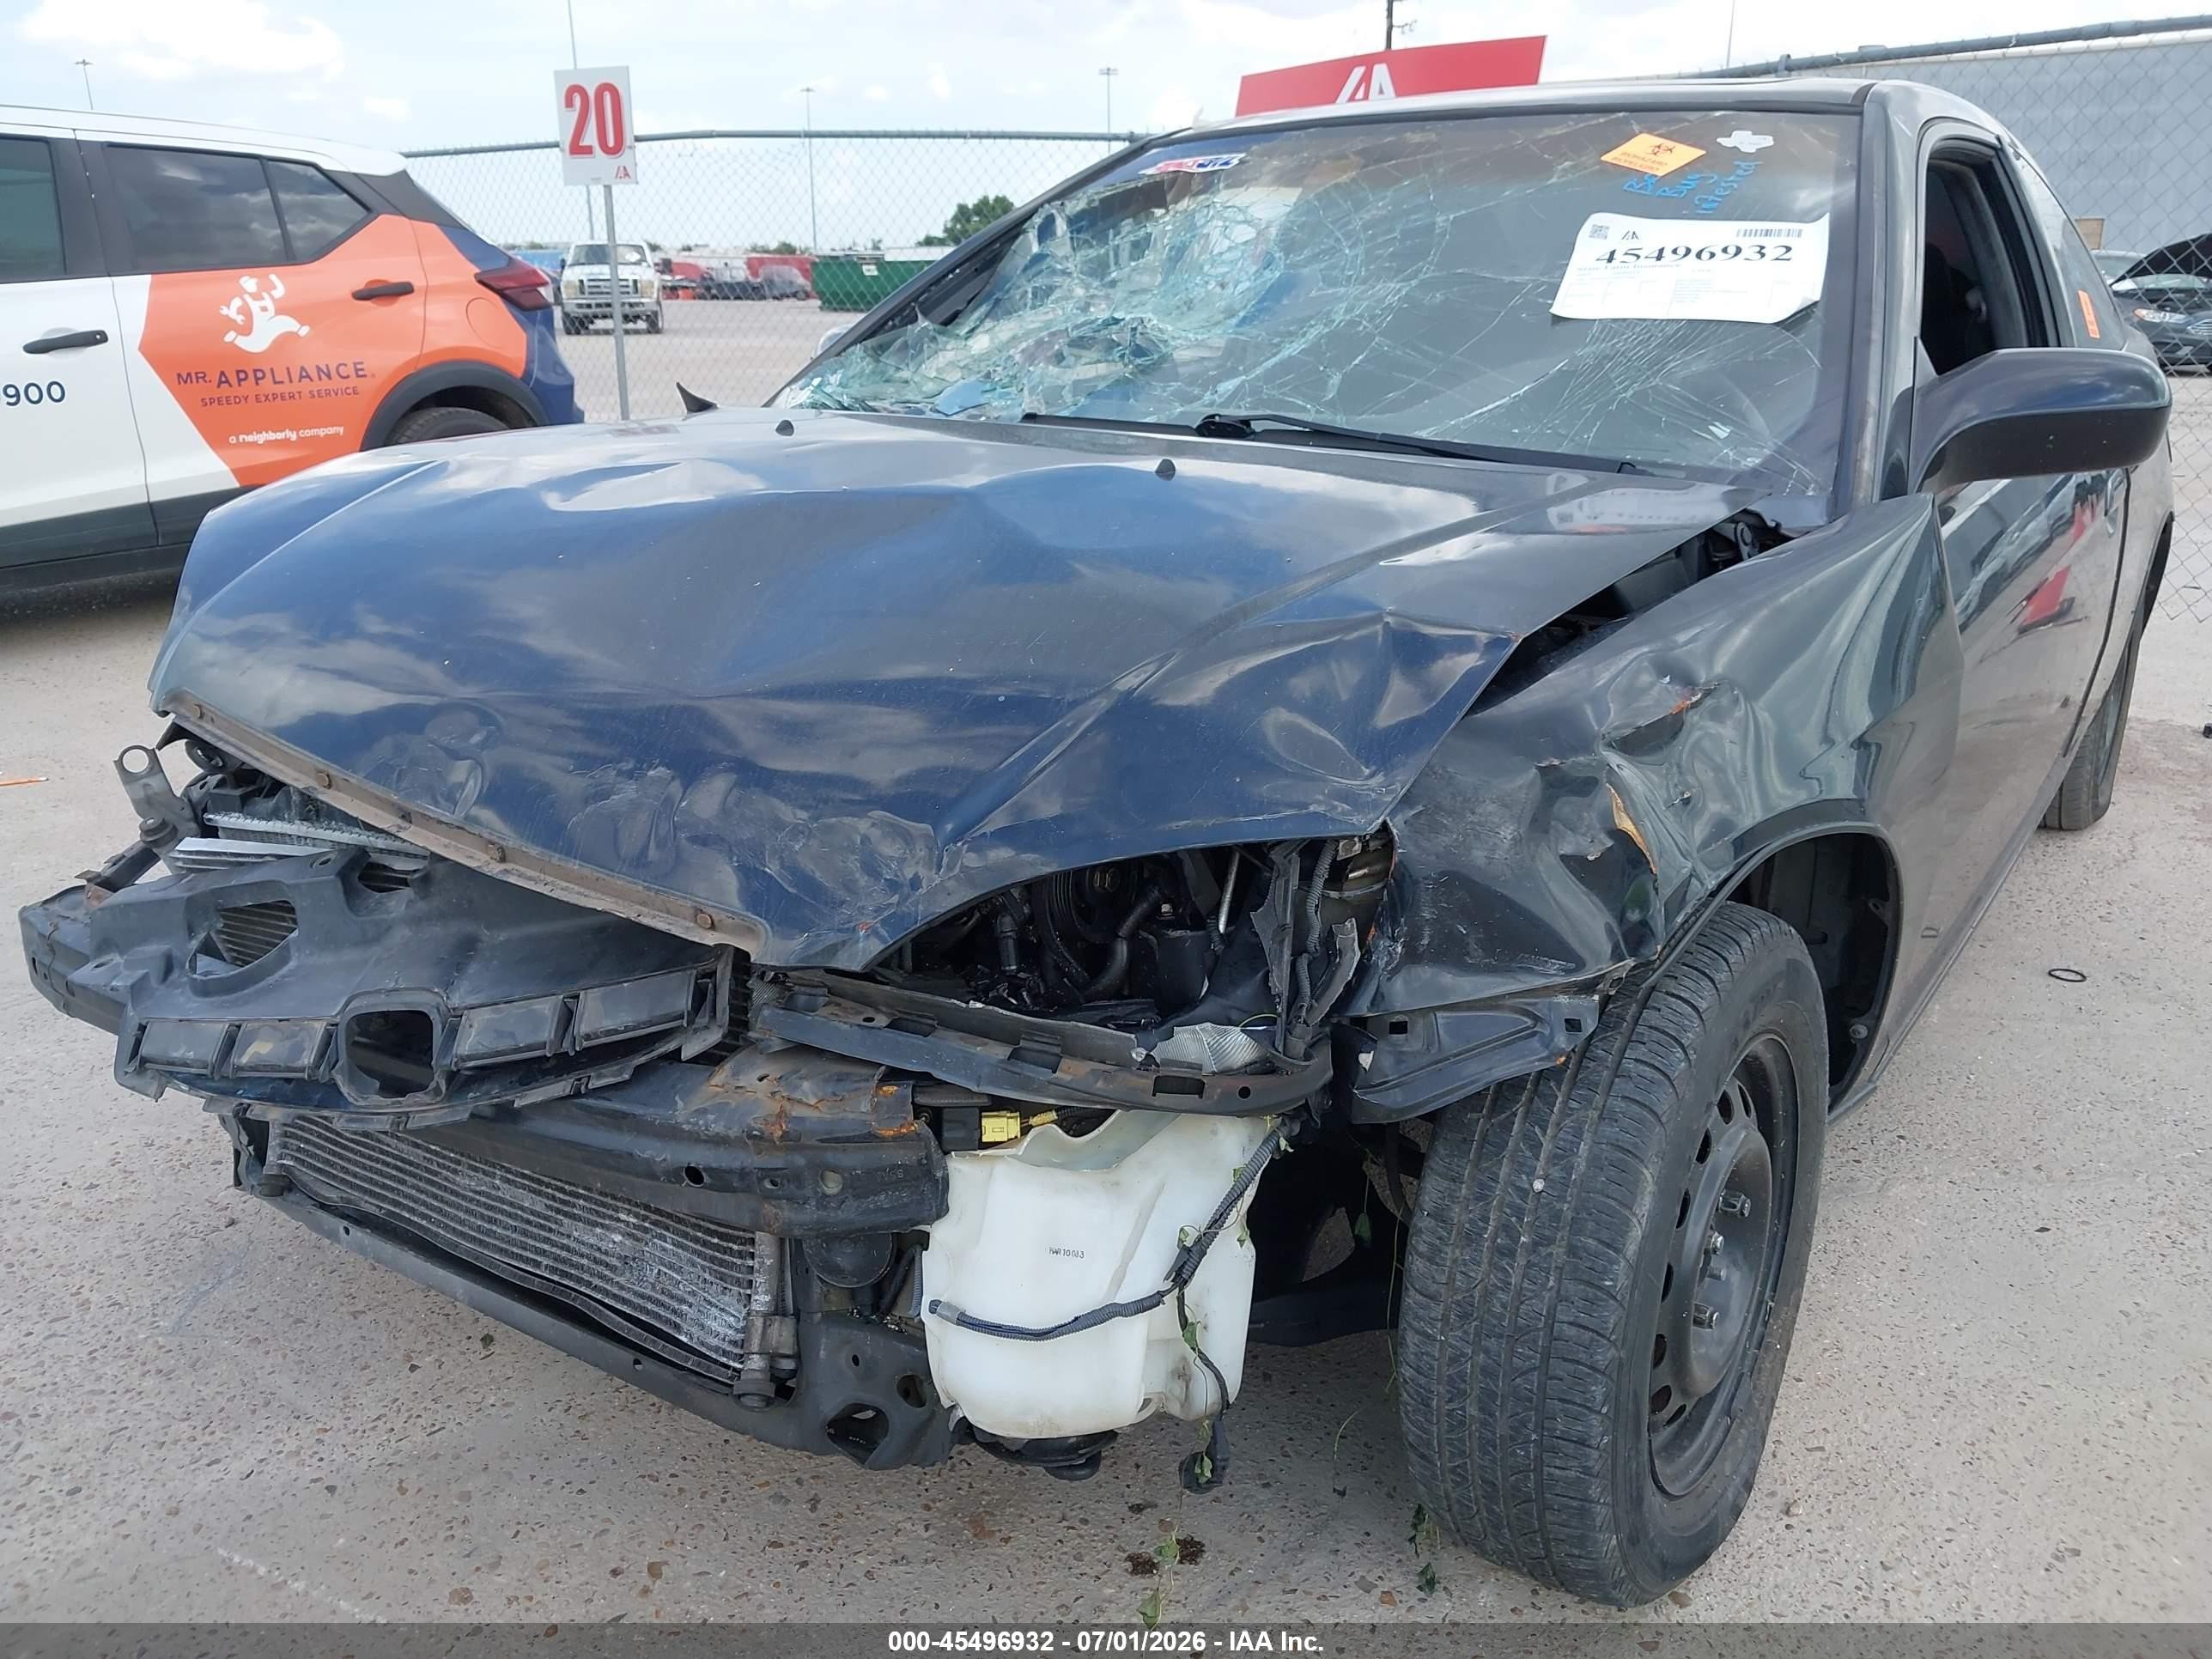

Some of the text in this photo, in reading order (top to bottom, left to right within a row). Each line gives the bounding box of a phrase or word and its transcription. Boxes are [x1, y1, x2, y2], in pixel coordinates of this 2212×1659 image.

[564, 82, 624, 156] 20
[1595, 244, 1793, 264] 45496932
[176, 361, 368, 389] MR. APPLIANCE
[2, 380, 66, 407] 900
[200, 386, 360, 407] SPEEDY EXPERT SERVICE
[228, 425, 345, 445] a neighborly company
